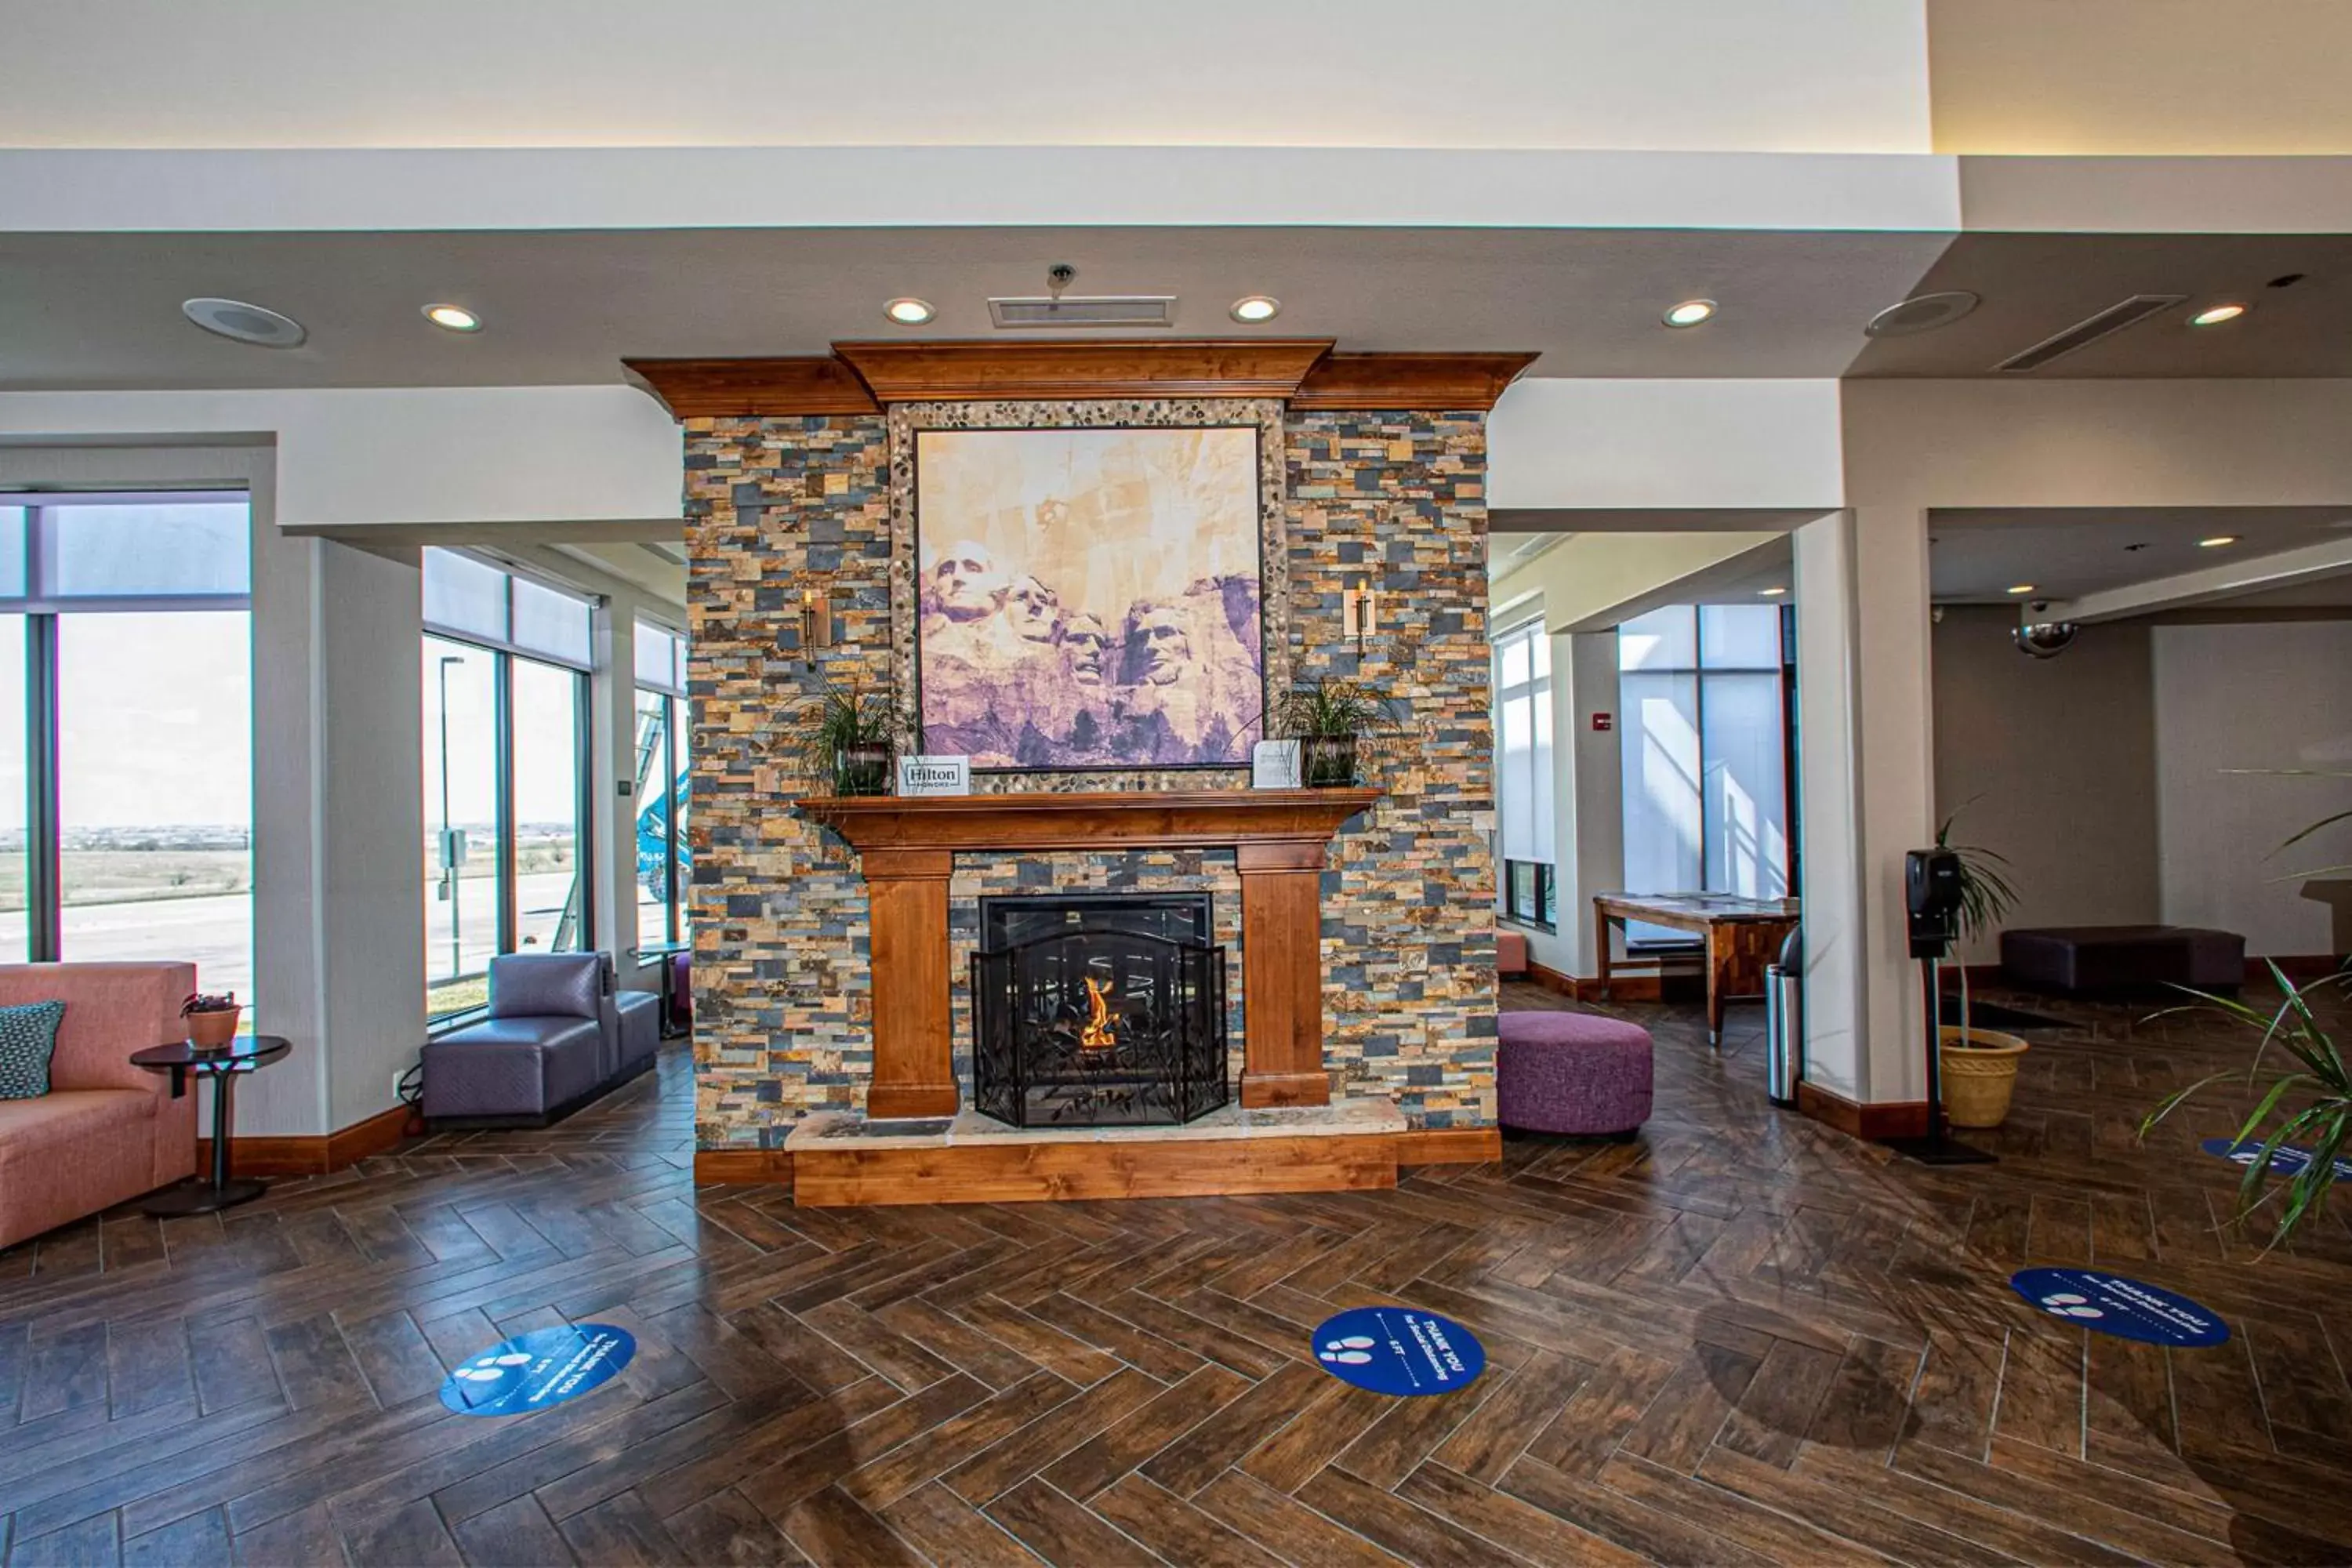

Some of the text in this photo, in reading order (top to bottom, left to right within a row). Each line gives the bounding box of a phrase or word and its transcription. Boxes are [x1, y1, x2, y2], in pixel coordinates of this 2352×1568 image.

[910, 768, 956, 780] Hilton
[1423, 1320, 1465, 1371] THANK YOU
